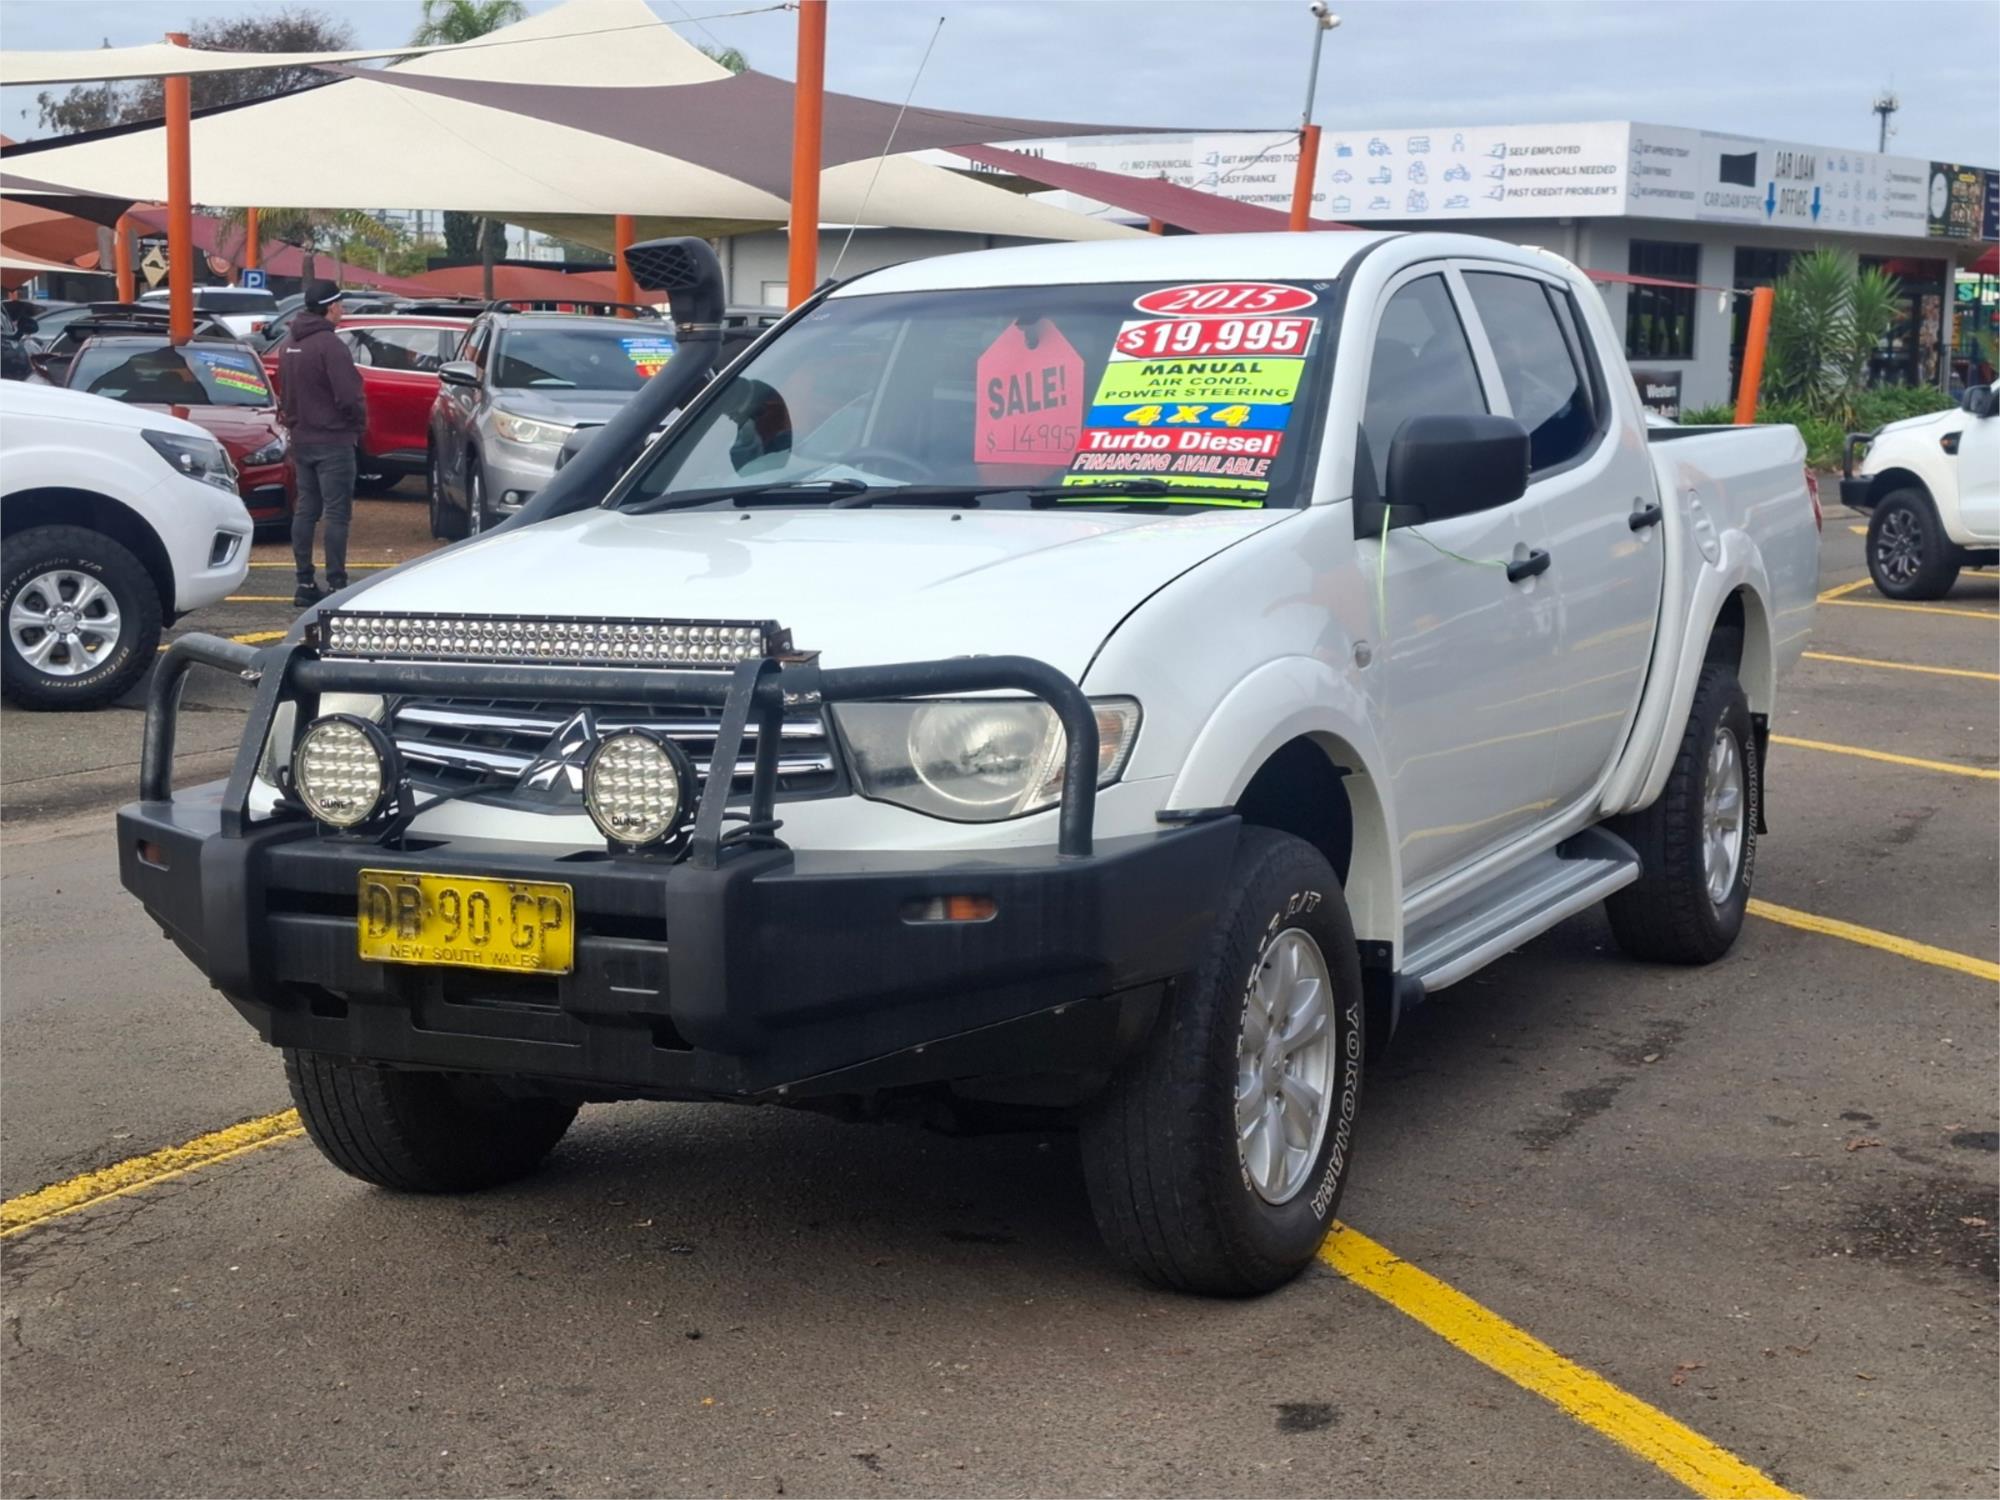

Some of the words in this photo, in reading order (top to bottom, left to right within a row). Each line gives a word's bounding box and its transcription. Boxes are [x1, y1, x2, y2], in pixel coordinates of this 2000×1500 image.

[1509, 146, 1530, 156] SELF
[1531, 145, 1581, 156] EMPLOYED
[1131, 161, 1145, 170] NO
[1220, 155, 1237, 164] GET
[1508, 168, 1523, 177] NO
[1523, 166, 1577, 177] FINANCIALS
[1579, 165, 1617, 175] NEEDED
[1242, 174, 1276, 184] FINANCE
[1507, 188, 1530, 198] PAST
[1530, 187, 1563, 197] CREDIT
[248, 274, 261, 288] P
[1164, 288, 1288, 311] 2015
[1123, 320, 1304, 354] $19,995
[1140, 362, 1263, 376] MANUAL
[1148, 378, 1183, 387] AIR
[1189, 376, 1253, 386] COND.
[987, 365, 1067, 420] SALE!
[1105, 389, 1177, 399] POWER
[1184, 387, 1290, 398] STEERING
[1010, 423, 1077, 453] 14995
[1089, 431, 1170, 450] Turbo
[1178, 431, 1274, 454] Diesel
[1072, 453, 1166, 472] FINANCING
[1169, 456, 1271, 477] AVAILABLE
[390, 944, 424, 959] NEW
[432, 948, 483, 964] SOUTH
[491, 951, 542, 969] WALES
[1311, 1002, 1362, 1221] YOKOHAMA
